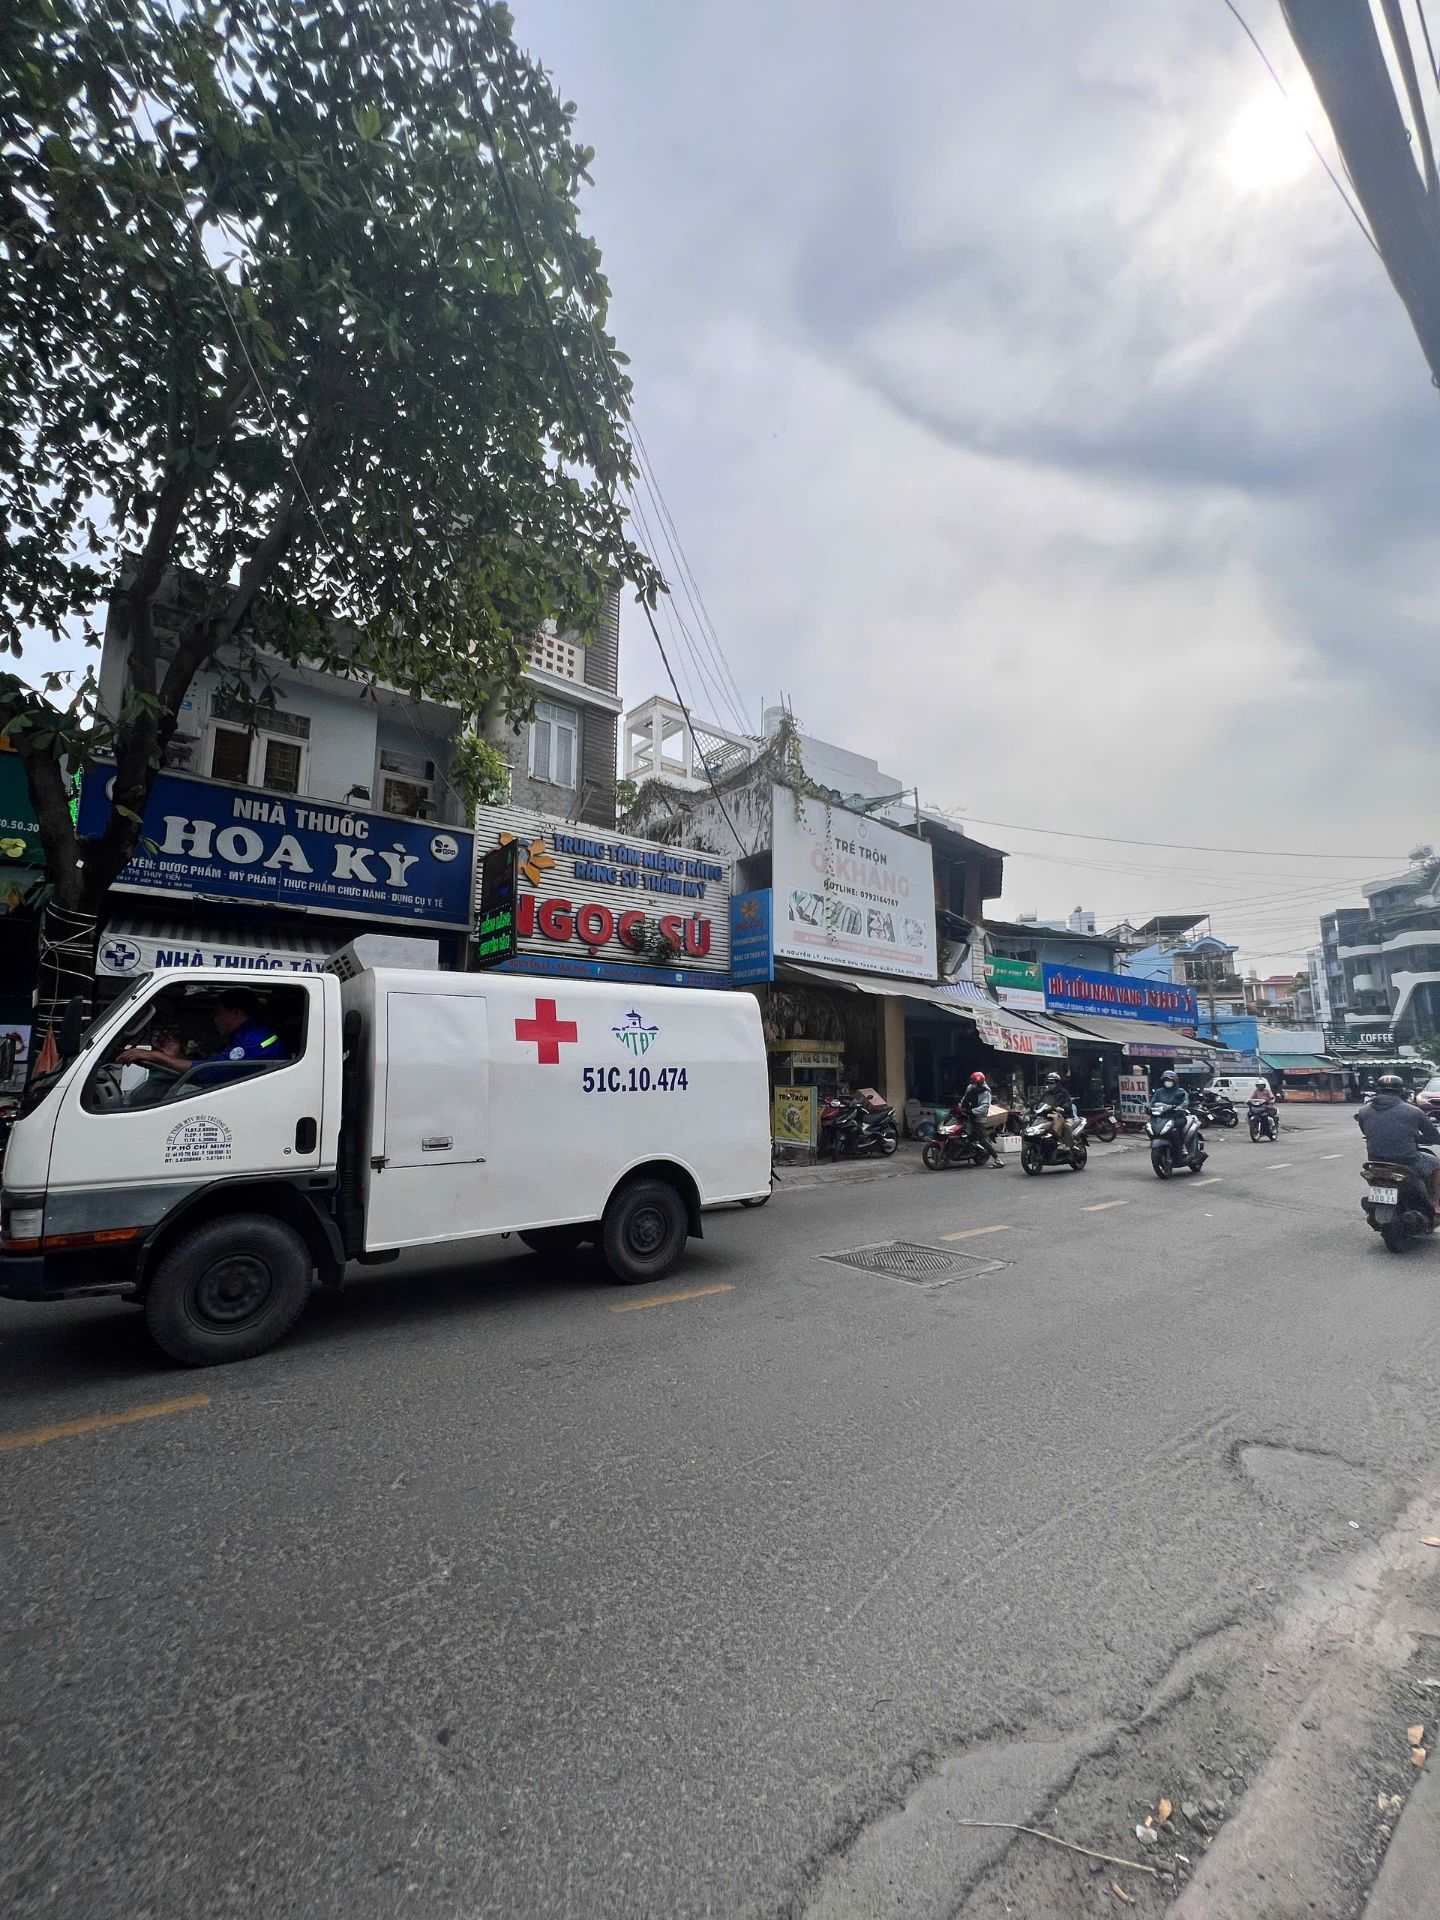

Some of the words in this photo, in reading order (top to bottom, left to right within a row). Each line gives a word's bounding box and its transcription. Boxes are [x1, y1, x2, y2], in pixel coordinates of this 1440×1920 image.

[233, 798, 286, 825] NHÀ
[295, 809, 370, 839] THUỐC
[159, 815, 314, 874] HOA
[331, 843, 420, 887] KỲ
[554, 833, 605, 859] TRUNG
[608, 843, 641, 865] TÂM
[835, 837, 855, 855] TRÉ
[858, 848, 887, 866] TRỘN
[127, 857, 157, 870] YÊN:
[191, 864, 222, 879] PHẨM
[248, 872, 277, 886] PHẨM
[283, 878, 307, 891] THỰC
[309, 880, 336, 893] PHẨM
[338, 884, 361, 897] CHỨC
[362, 887, 387, 900] NĂNG
[156, 949, 204, 968] NHÀ
[1091, 983, 1117, 1003] NAM
[1117, 987, 1143, 1007] VANG
[1360, 1033, 1394, 1043] COFFEE
[582, 1067, 689, 1093] 51C.10.474
